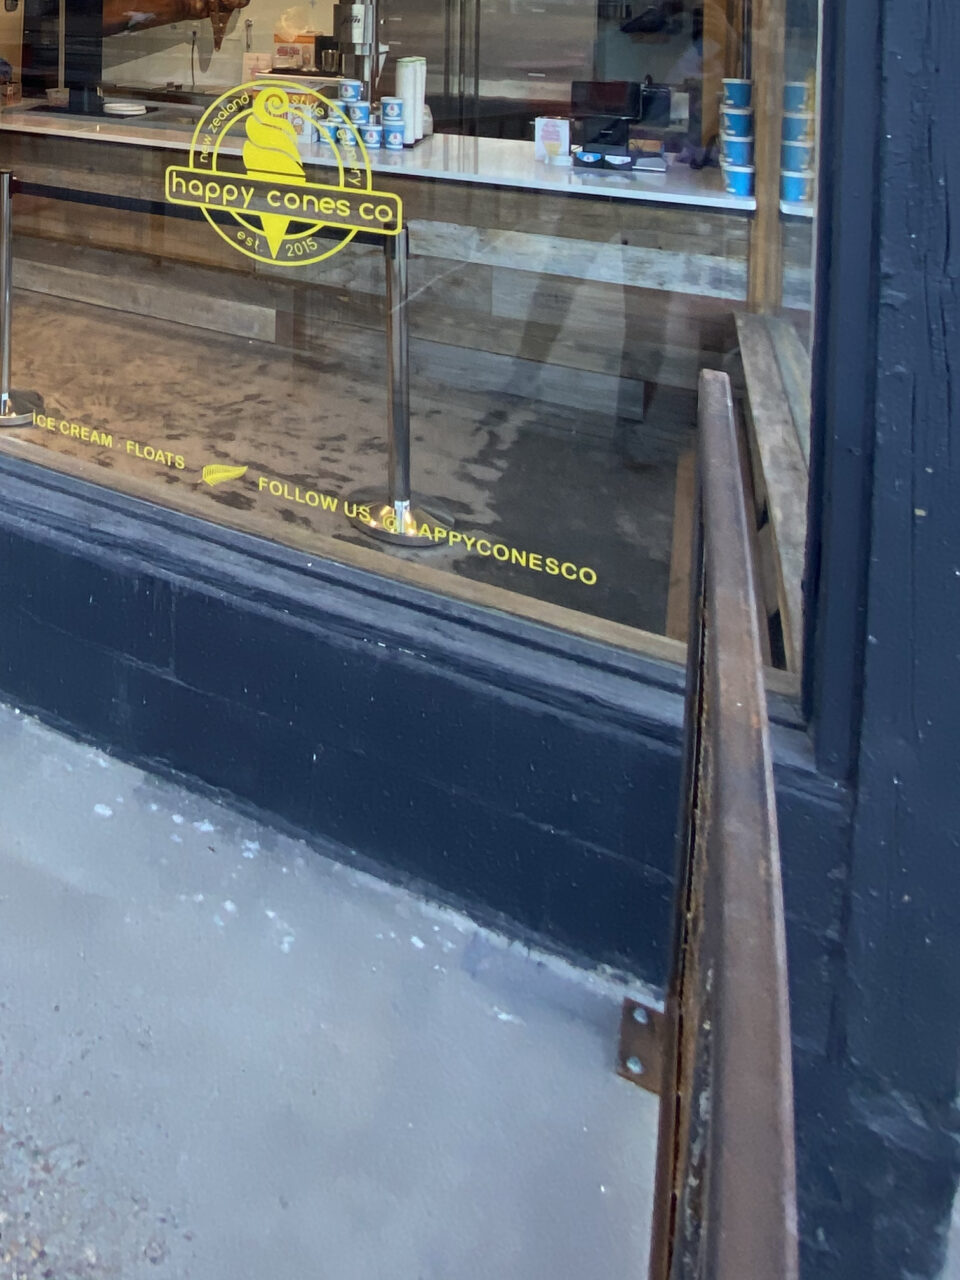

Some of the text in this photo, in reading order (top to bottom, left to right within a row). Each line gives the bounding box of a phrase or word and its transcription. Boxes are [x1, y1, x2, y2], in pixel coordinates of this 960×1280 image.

[200, 134, 212, 163] new
[207, 91, 250, 134] zealand
[171, 171, 393, 223] happy cones co
[236, 230, 318, 257] est. 2015
[32, 410, 185, 469] ICE CREAM FLOATS
[258, 476, 338, 513] FOLLOW
[343, 501, 372, 524] US
